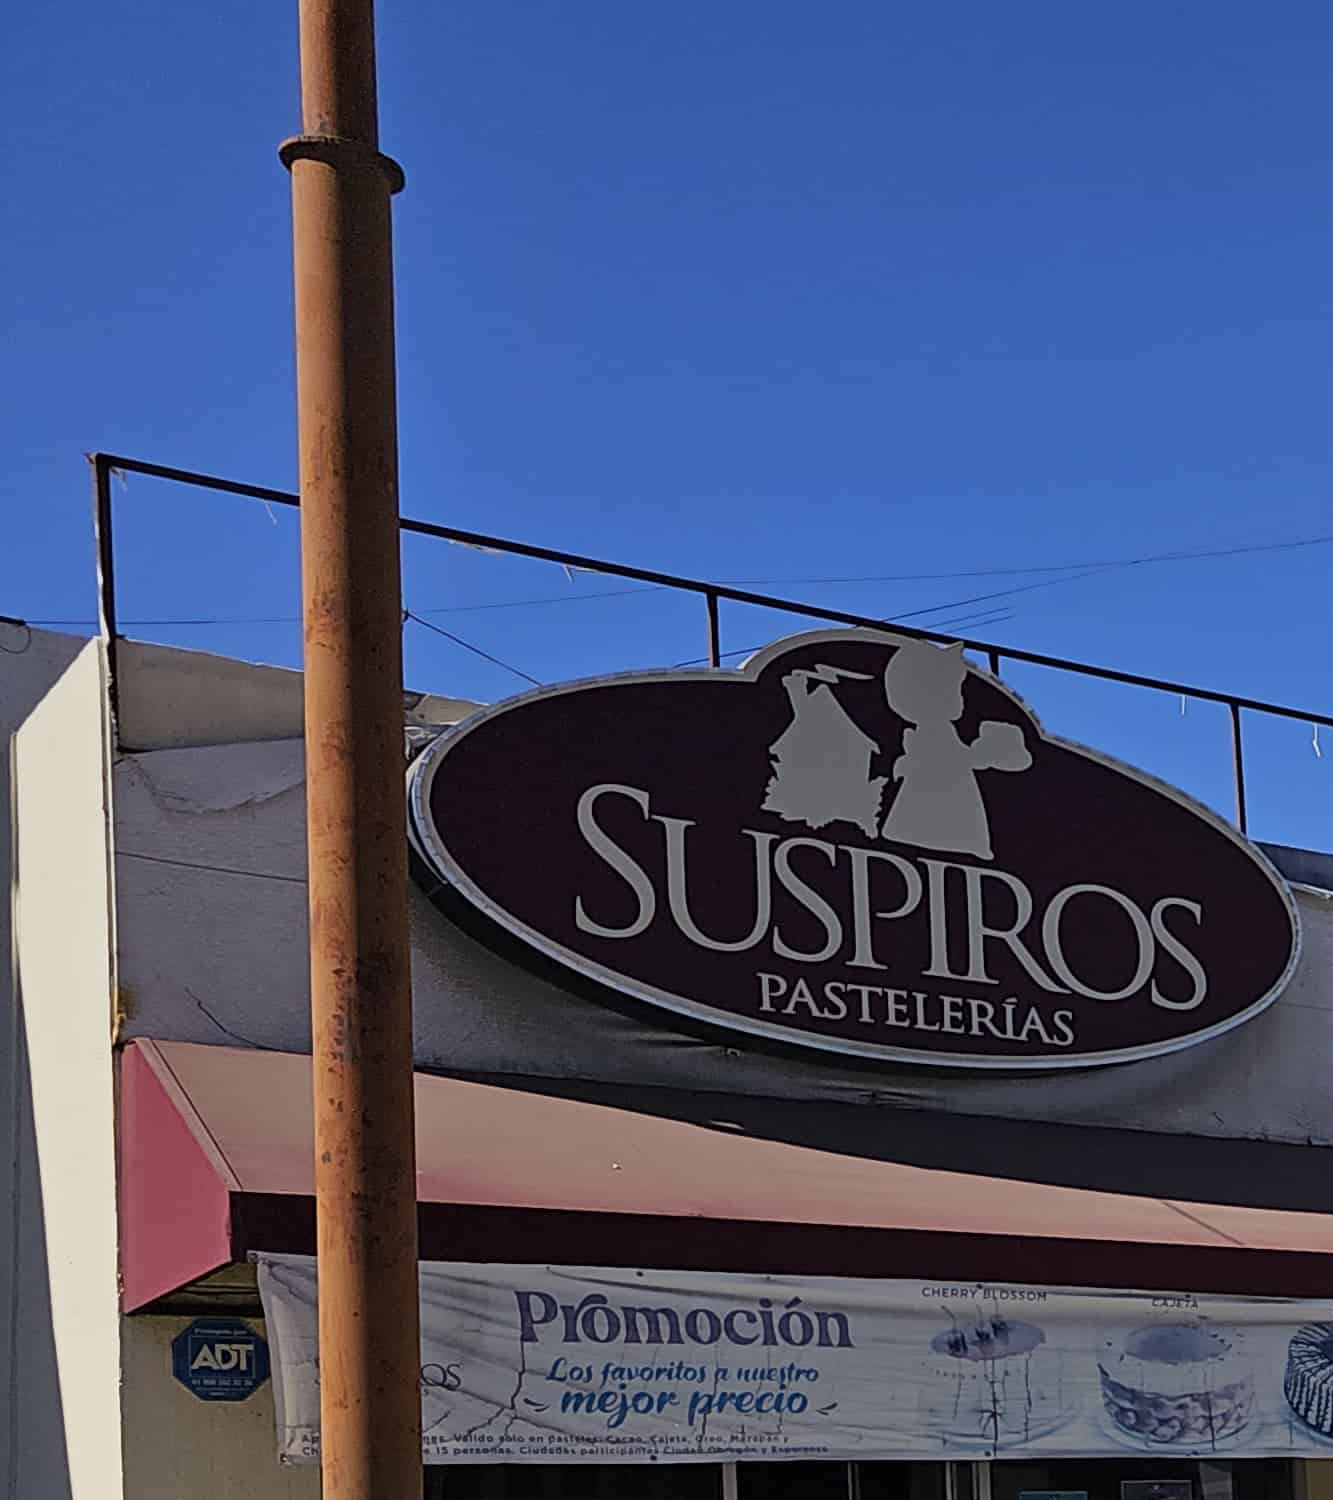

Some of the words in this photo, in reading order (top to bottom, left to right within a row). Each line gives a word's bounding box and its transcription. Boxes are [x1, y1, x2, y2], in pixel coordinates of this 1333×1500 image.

[576, 784, 1207, 1010] SUSPIROS
[756, 972, 1075, 1046] PASTELERÍAS
[921, 1287, 977, 1298] CHERRY
[983, 1287, 1047, 1302] BLOSSOM
[514, 1290, 855, 1348] Promoción
[192, 1344, 254, 1370] ADT
[545, 1357, 594, 1384] Los
[599, 1361, 707, 1388] favoritos
[736, 1362, 820, 1385] nuestro
[560, 1385, 681, 1428] mejor
[688, 1385, 809, 1427] precio
